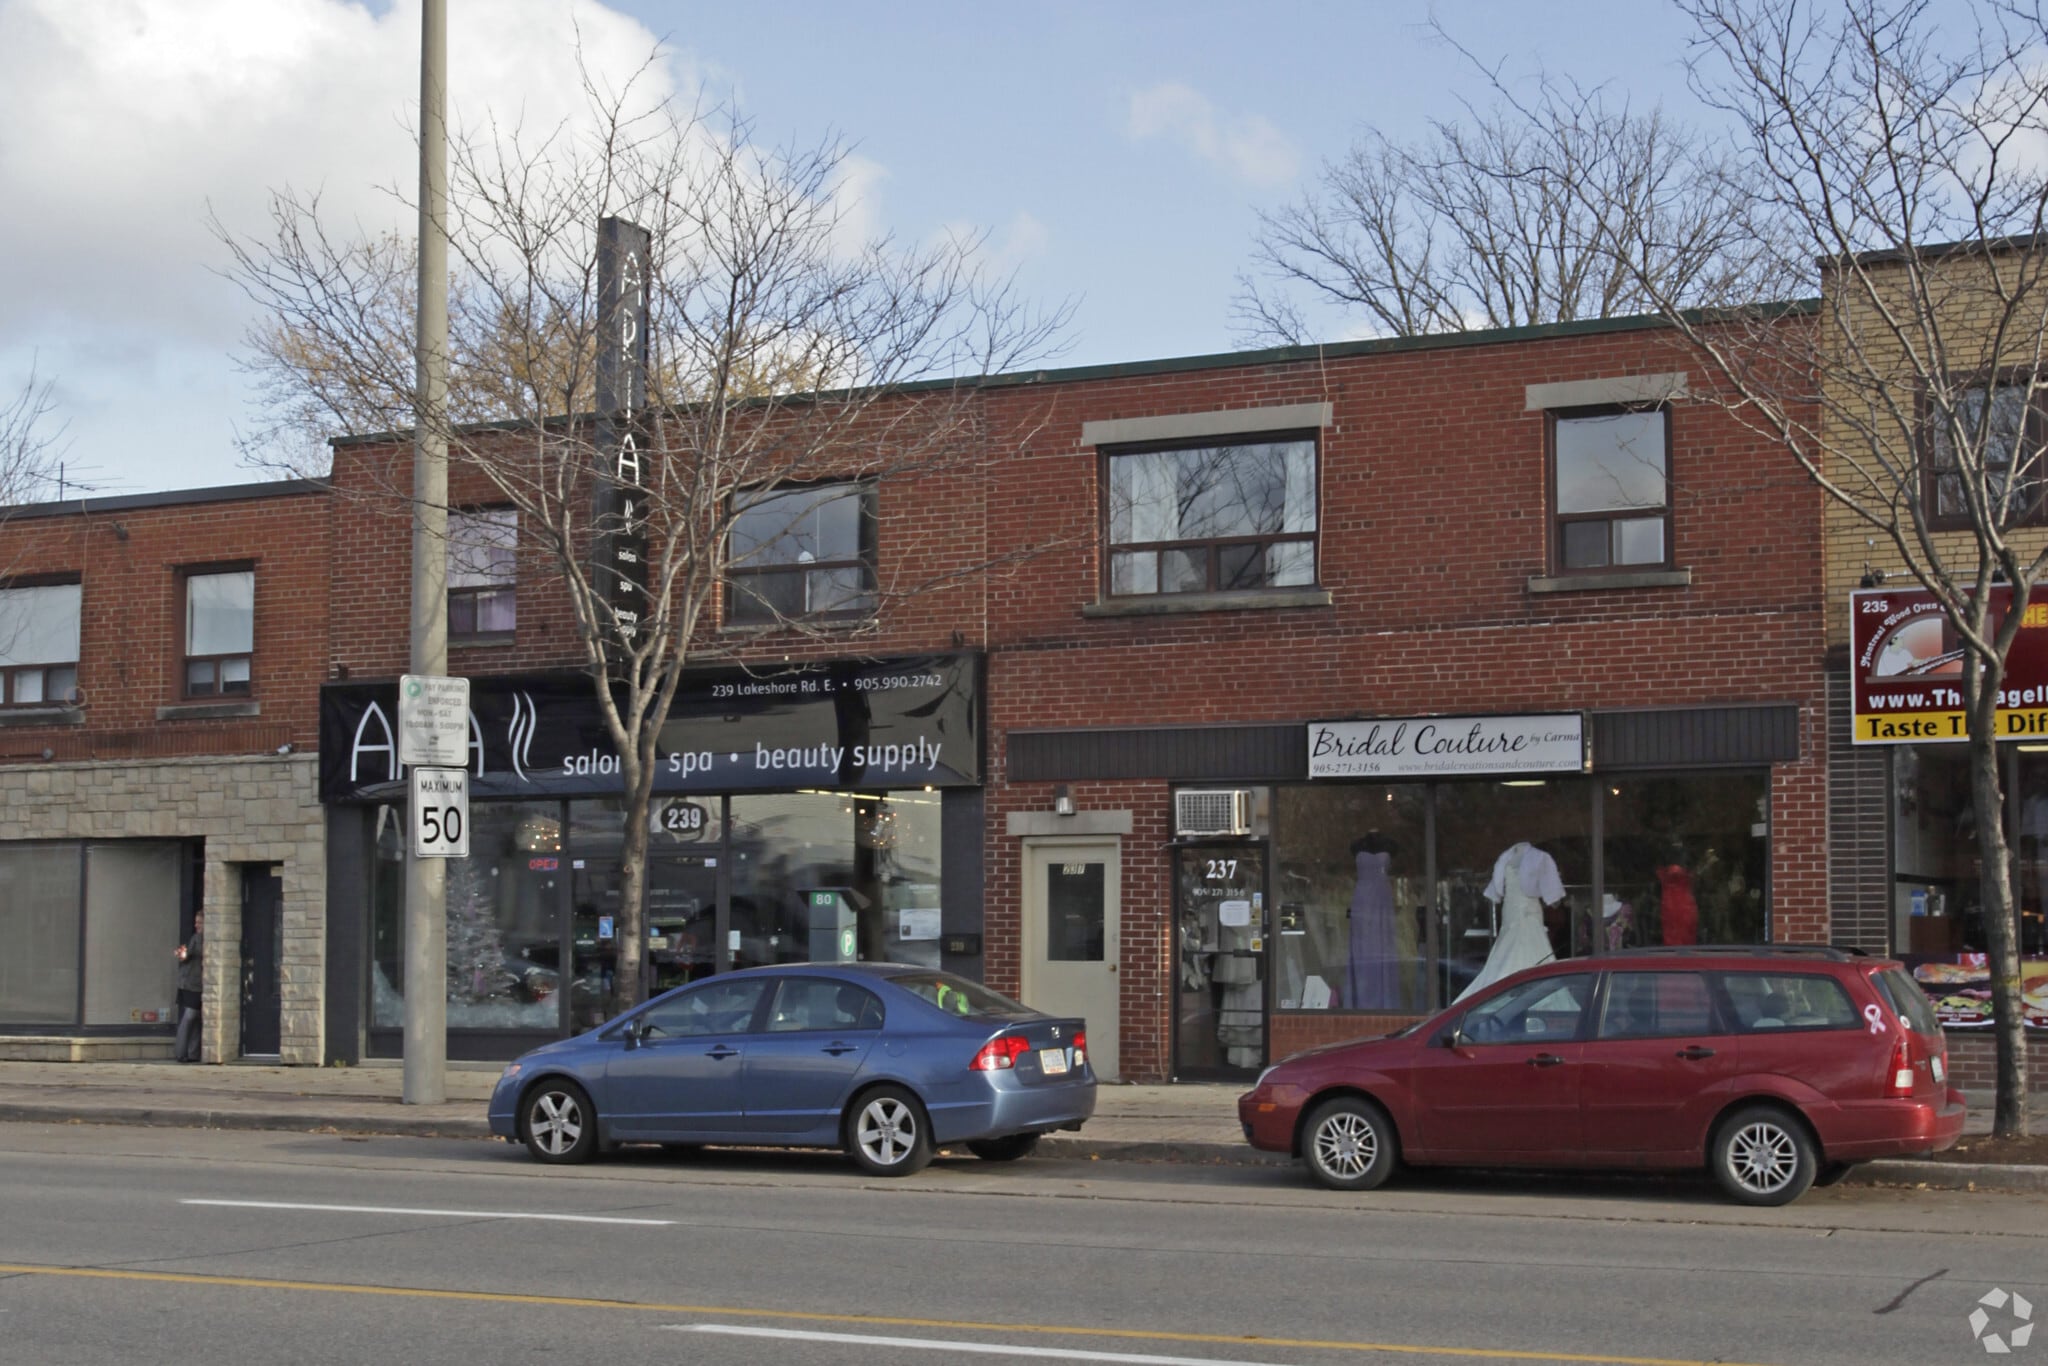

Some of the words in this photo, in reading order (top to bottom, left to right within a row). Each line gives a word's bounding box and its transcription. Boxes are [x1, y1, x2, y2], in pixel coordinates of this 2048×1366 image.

[1862, 600, 1888, 614] 235
[1913, 602, 1937, 613] Oven
[712, 684, 734, 697] 239
[737, 681, 797, 695] Lakeshore
[801, 680, 821, 693] Rd.
[824, 679, 836, 692] E.
[854, 674, 942, 690] 905.990.2742
[1867, 718, 1938, 738] Taste
[1312, 722, 1408, 758] Bridal
[1414, 722, 1528, 756] Couture
[1529, 732, 1542, 745] by
[1543, 732, 1580, 743] Carma
[668, 750, 713, 779] spa
[755, 741, 845, 775] beauty
[852, 735, 942, 773] supply
[1312, 762, 1381, 774] 905-271-3156
[1397, 759, 1580, 772] www.bridalcreationsandcouture.com
[420, 780, 463, 793] MAXIMUM
[422, 806, 462, 844] 50
[666, 807, 702, 829] 239
[1205, 859, 1238, 879] 237
[815, 893, 832, 905] 80
